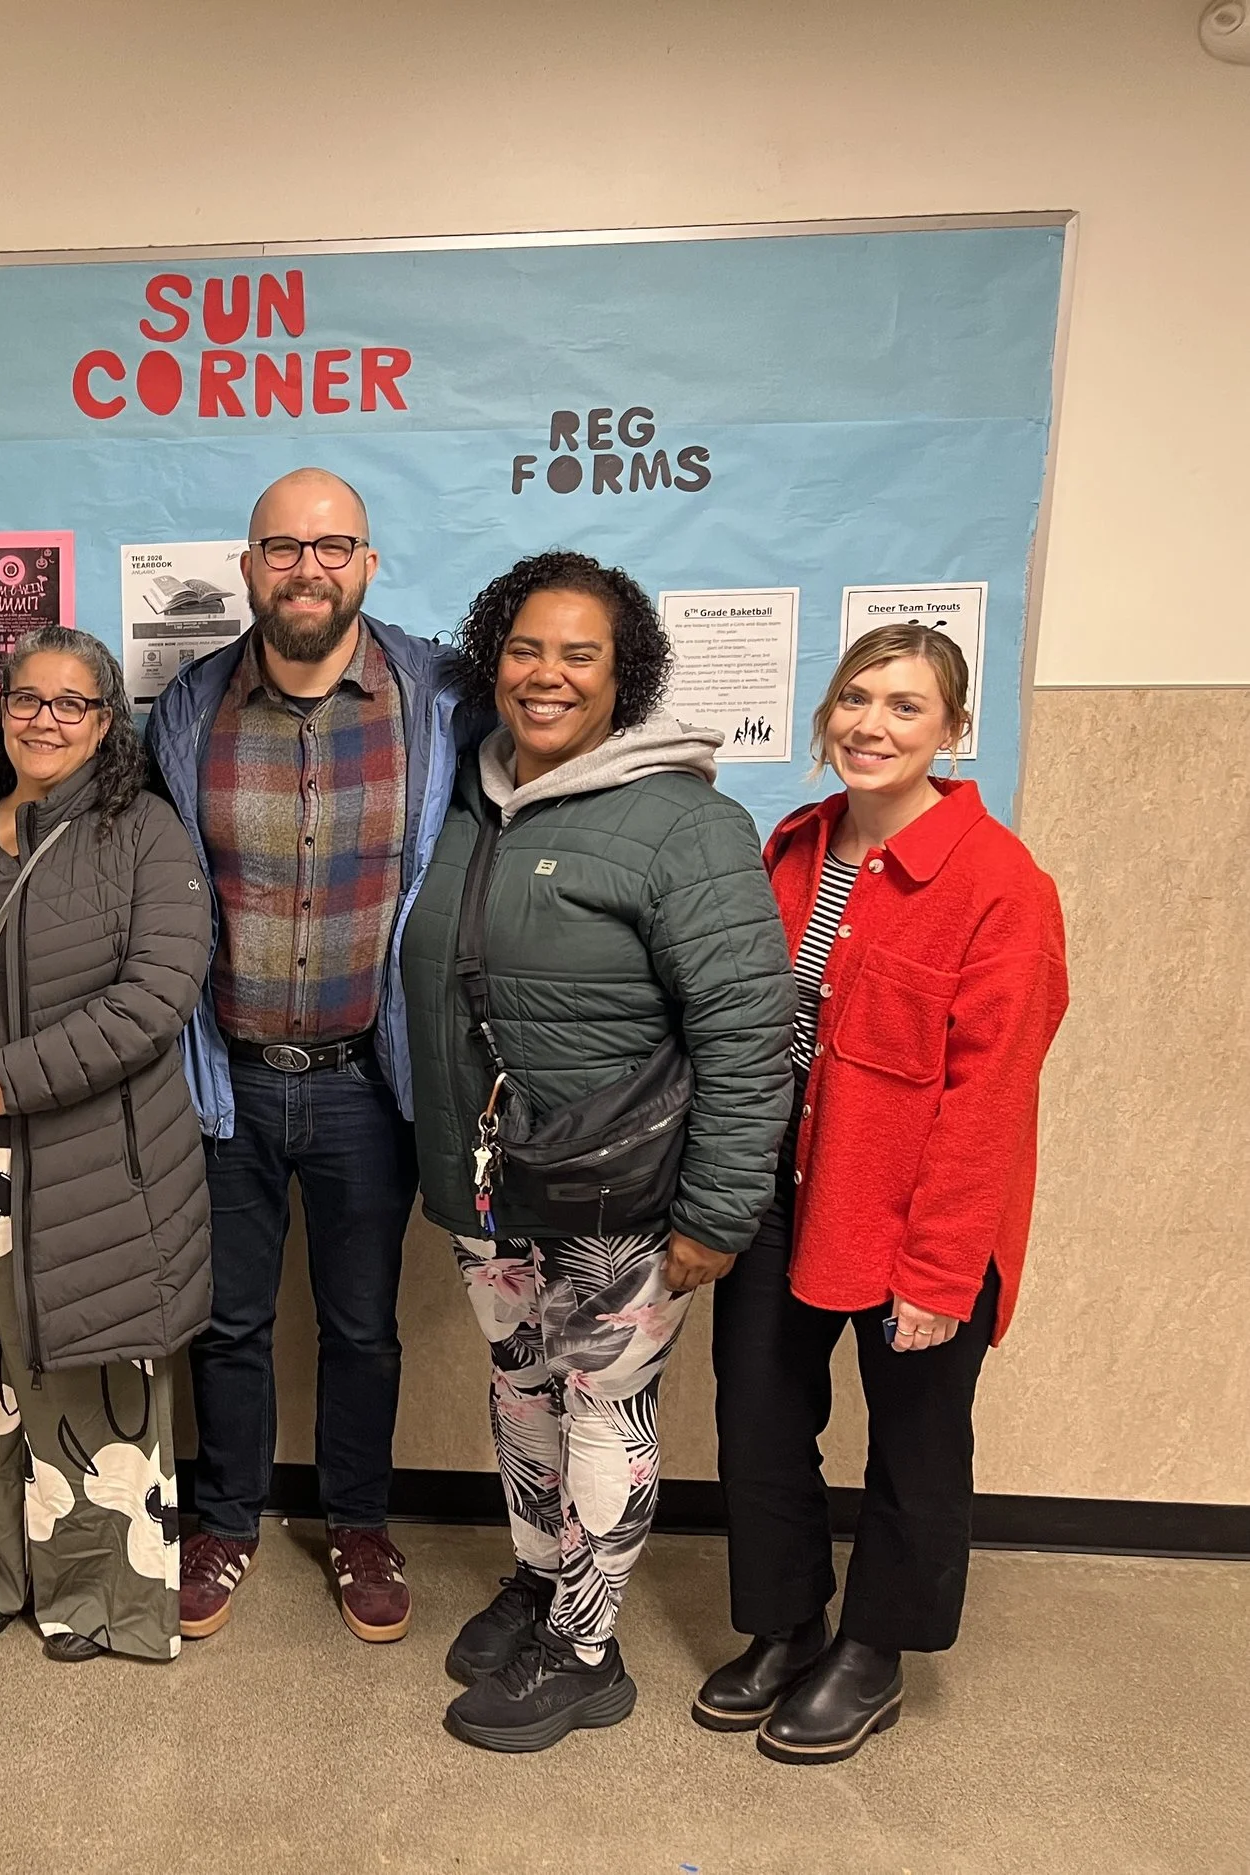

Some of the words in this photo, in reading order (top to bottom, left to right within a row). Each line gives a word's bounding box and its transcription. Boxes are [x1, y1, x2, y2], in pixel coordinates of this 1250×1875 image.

[139, 269, 306, 345] SUN
[72, 347, 412, 420] CORNER
[550, 406, 655, 451] REG
[511, 445, 712, 494] FORMS
[700, 609, 728, 617] Grade
[730, 607, 773, 616] Baketball
[868, 605, 895, 613] Cheer
[898, 604, 923, 612] Team
[927, 603, 961, 613] Tryouts
[188, 878, 201, 891] ck
